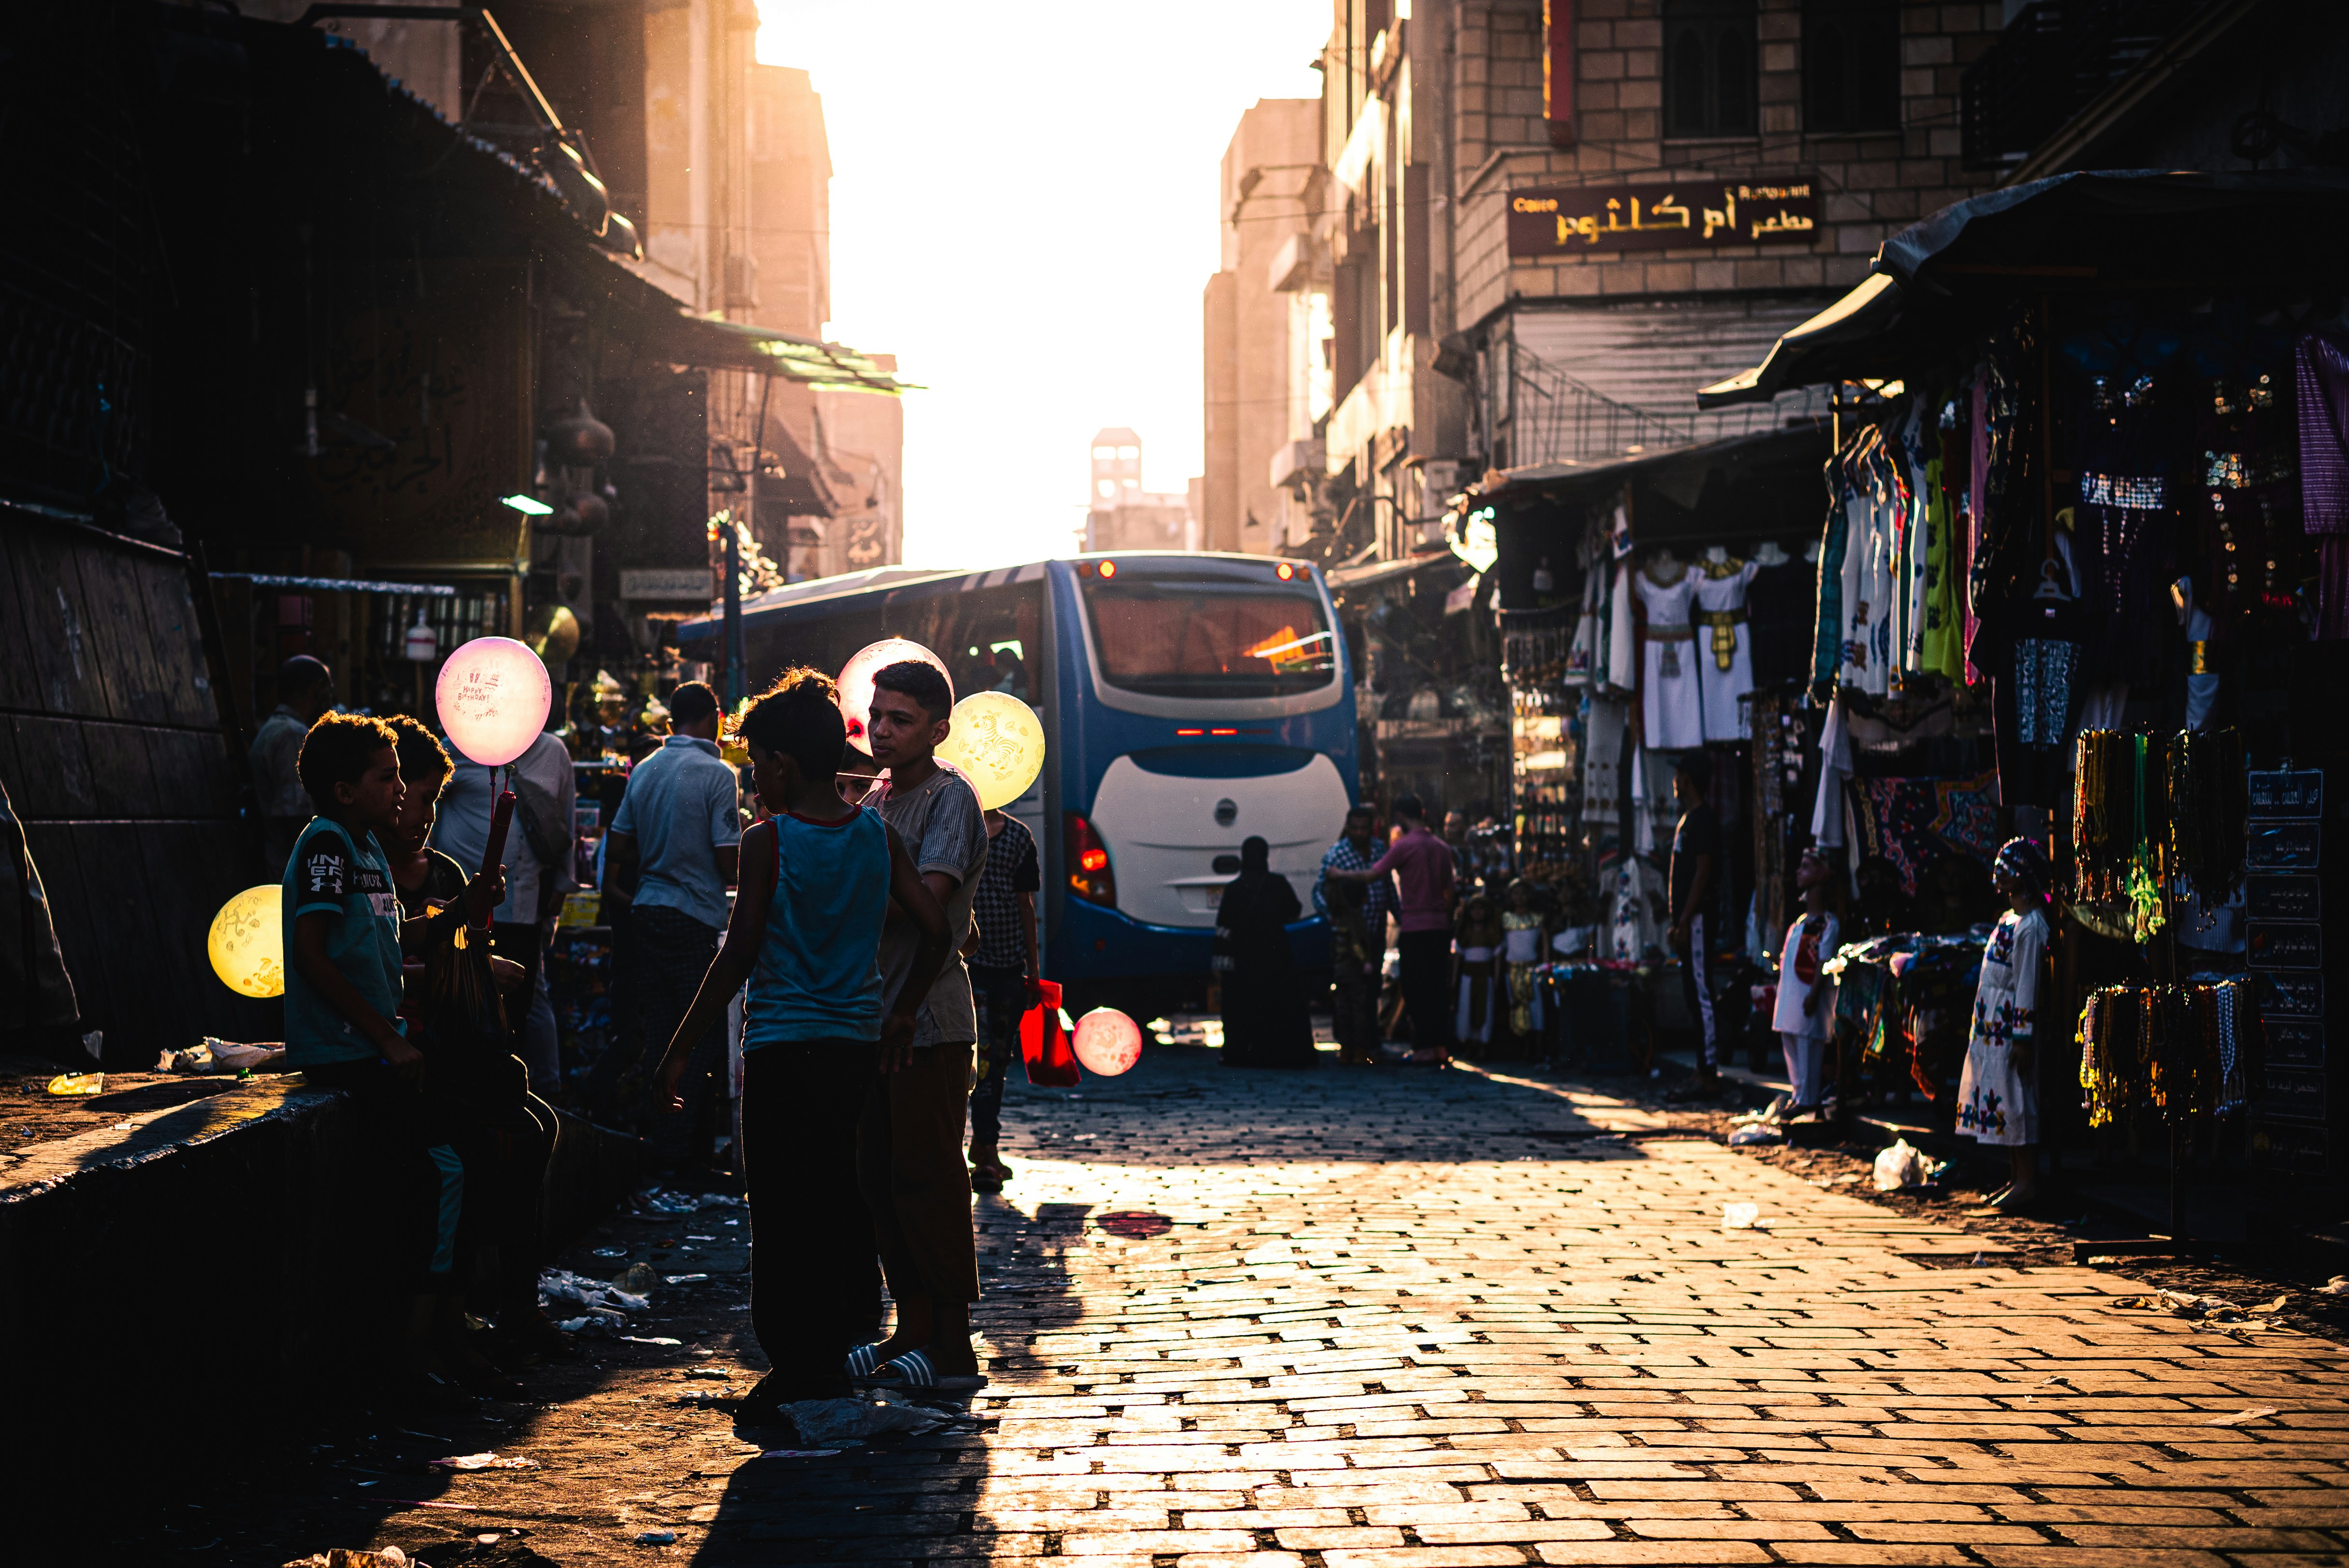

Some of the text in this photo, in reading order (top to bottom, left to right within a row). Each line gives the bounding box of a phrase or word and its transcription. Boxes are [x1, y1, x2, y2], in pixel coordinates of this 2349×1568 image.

[1555, 194, 1690, 245] كلثوم
[463, 686, 482, 694] HAPPY
[458, 693, 489, 703] BIRTHDAY!
